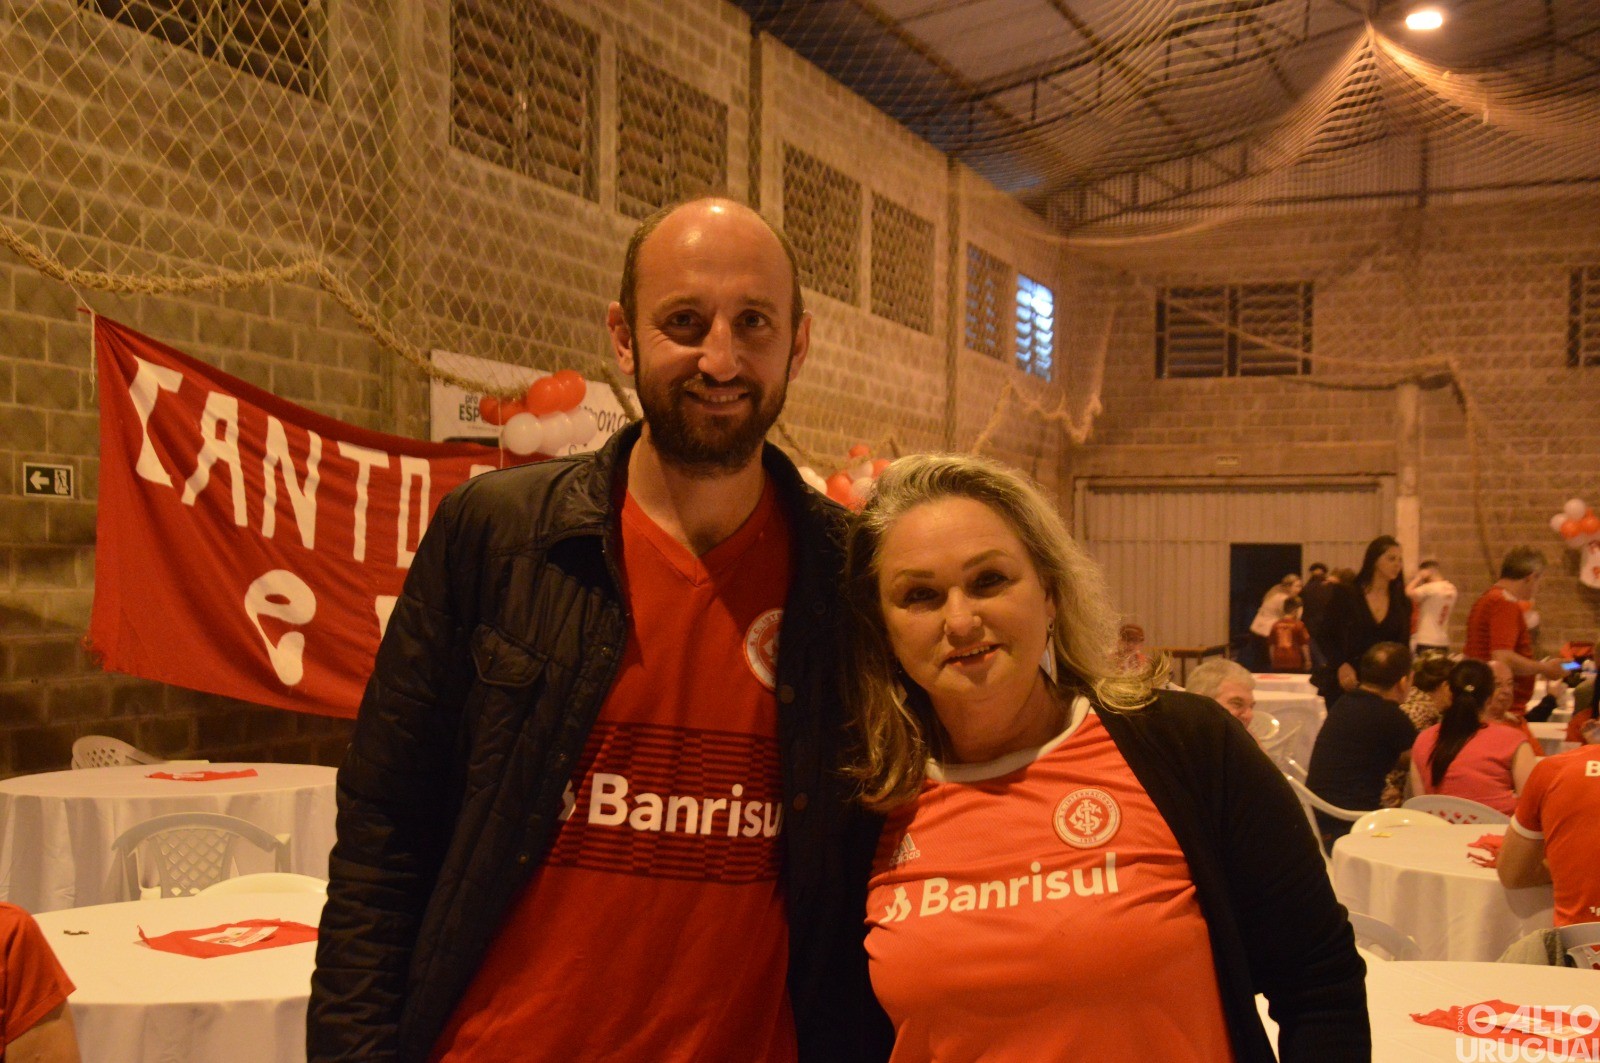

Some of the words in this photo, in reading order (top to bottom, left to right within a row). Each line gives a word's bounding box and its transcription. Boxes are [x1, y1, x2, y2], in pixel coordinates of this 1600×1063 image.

[459, 404, 480, 422] ESP
[588, 773, 782, 837] Banrisu
[919, 851, 1120, 918] Banrisul
